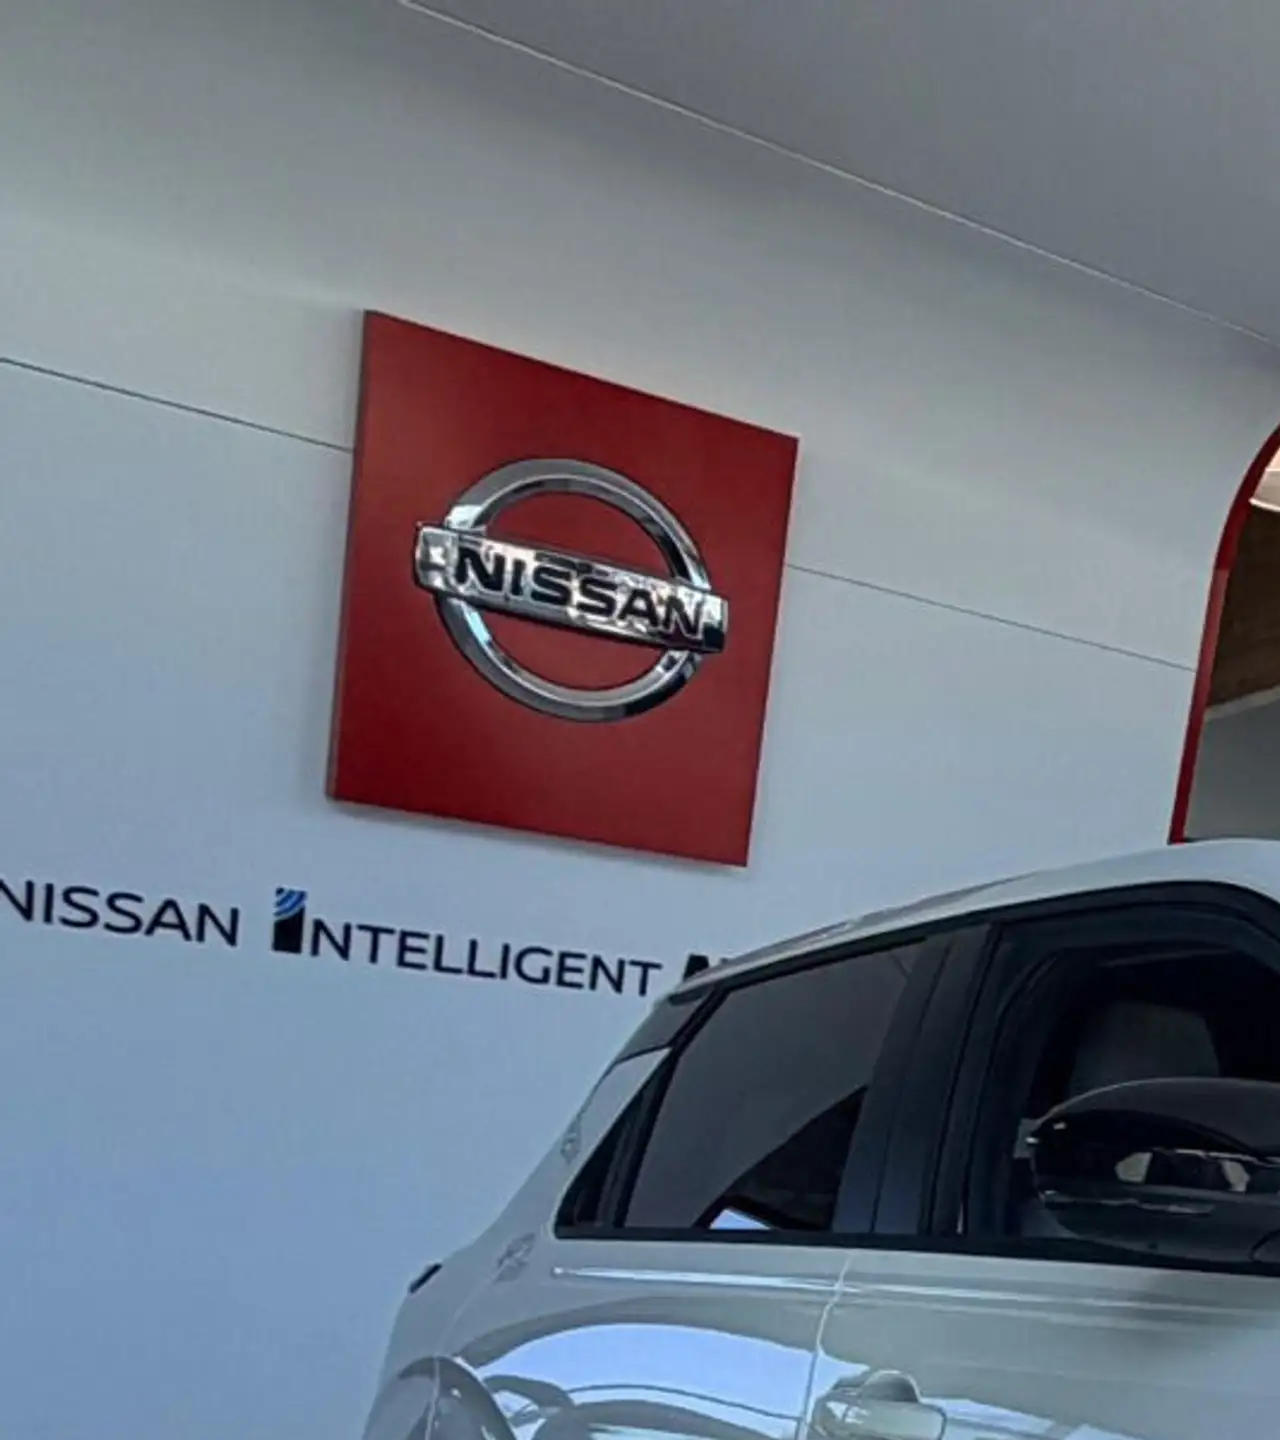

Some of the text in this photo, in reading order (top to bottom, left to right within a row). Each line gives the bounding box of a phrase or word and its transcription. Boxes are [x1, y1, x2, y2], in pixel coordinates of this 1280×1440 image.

[454, 548, 704, 637] NISSAN
[0, 878, 664, 998] NISSAN INTELLIGENT
